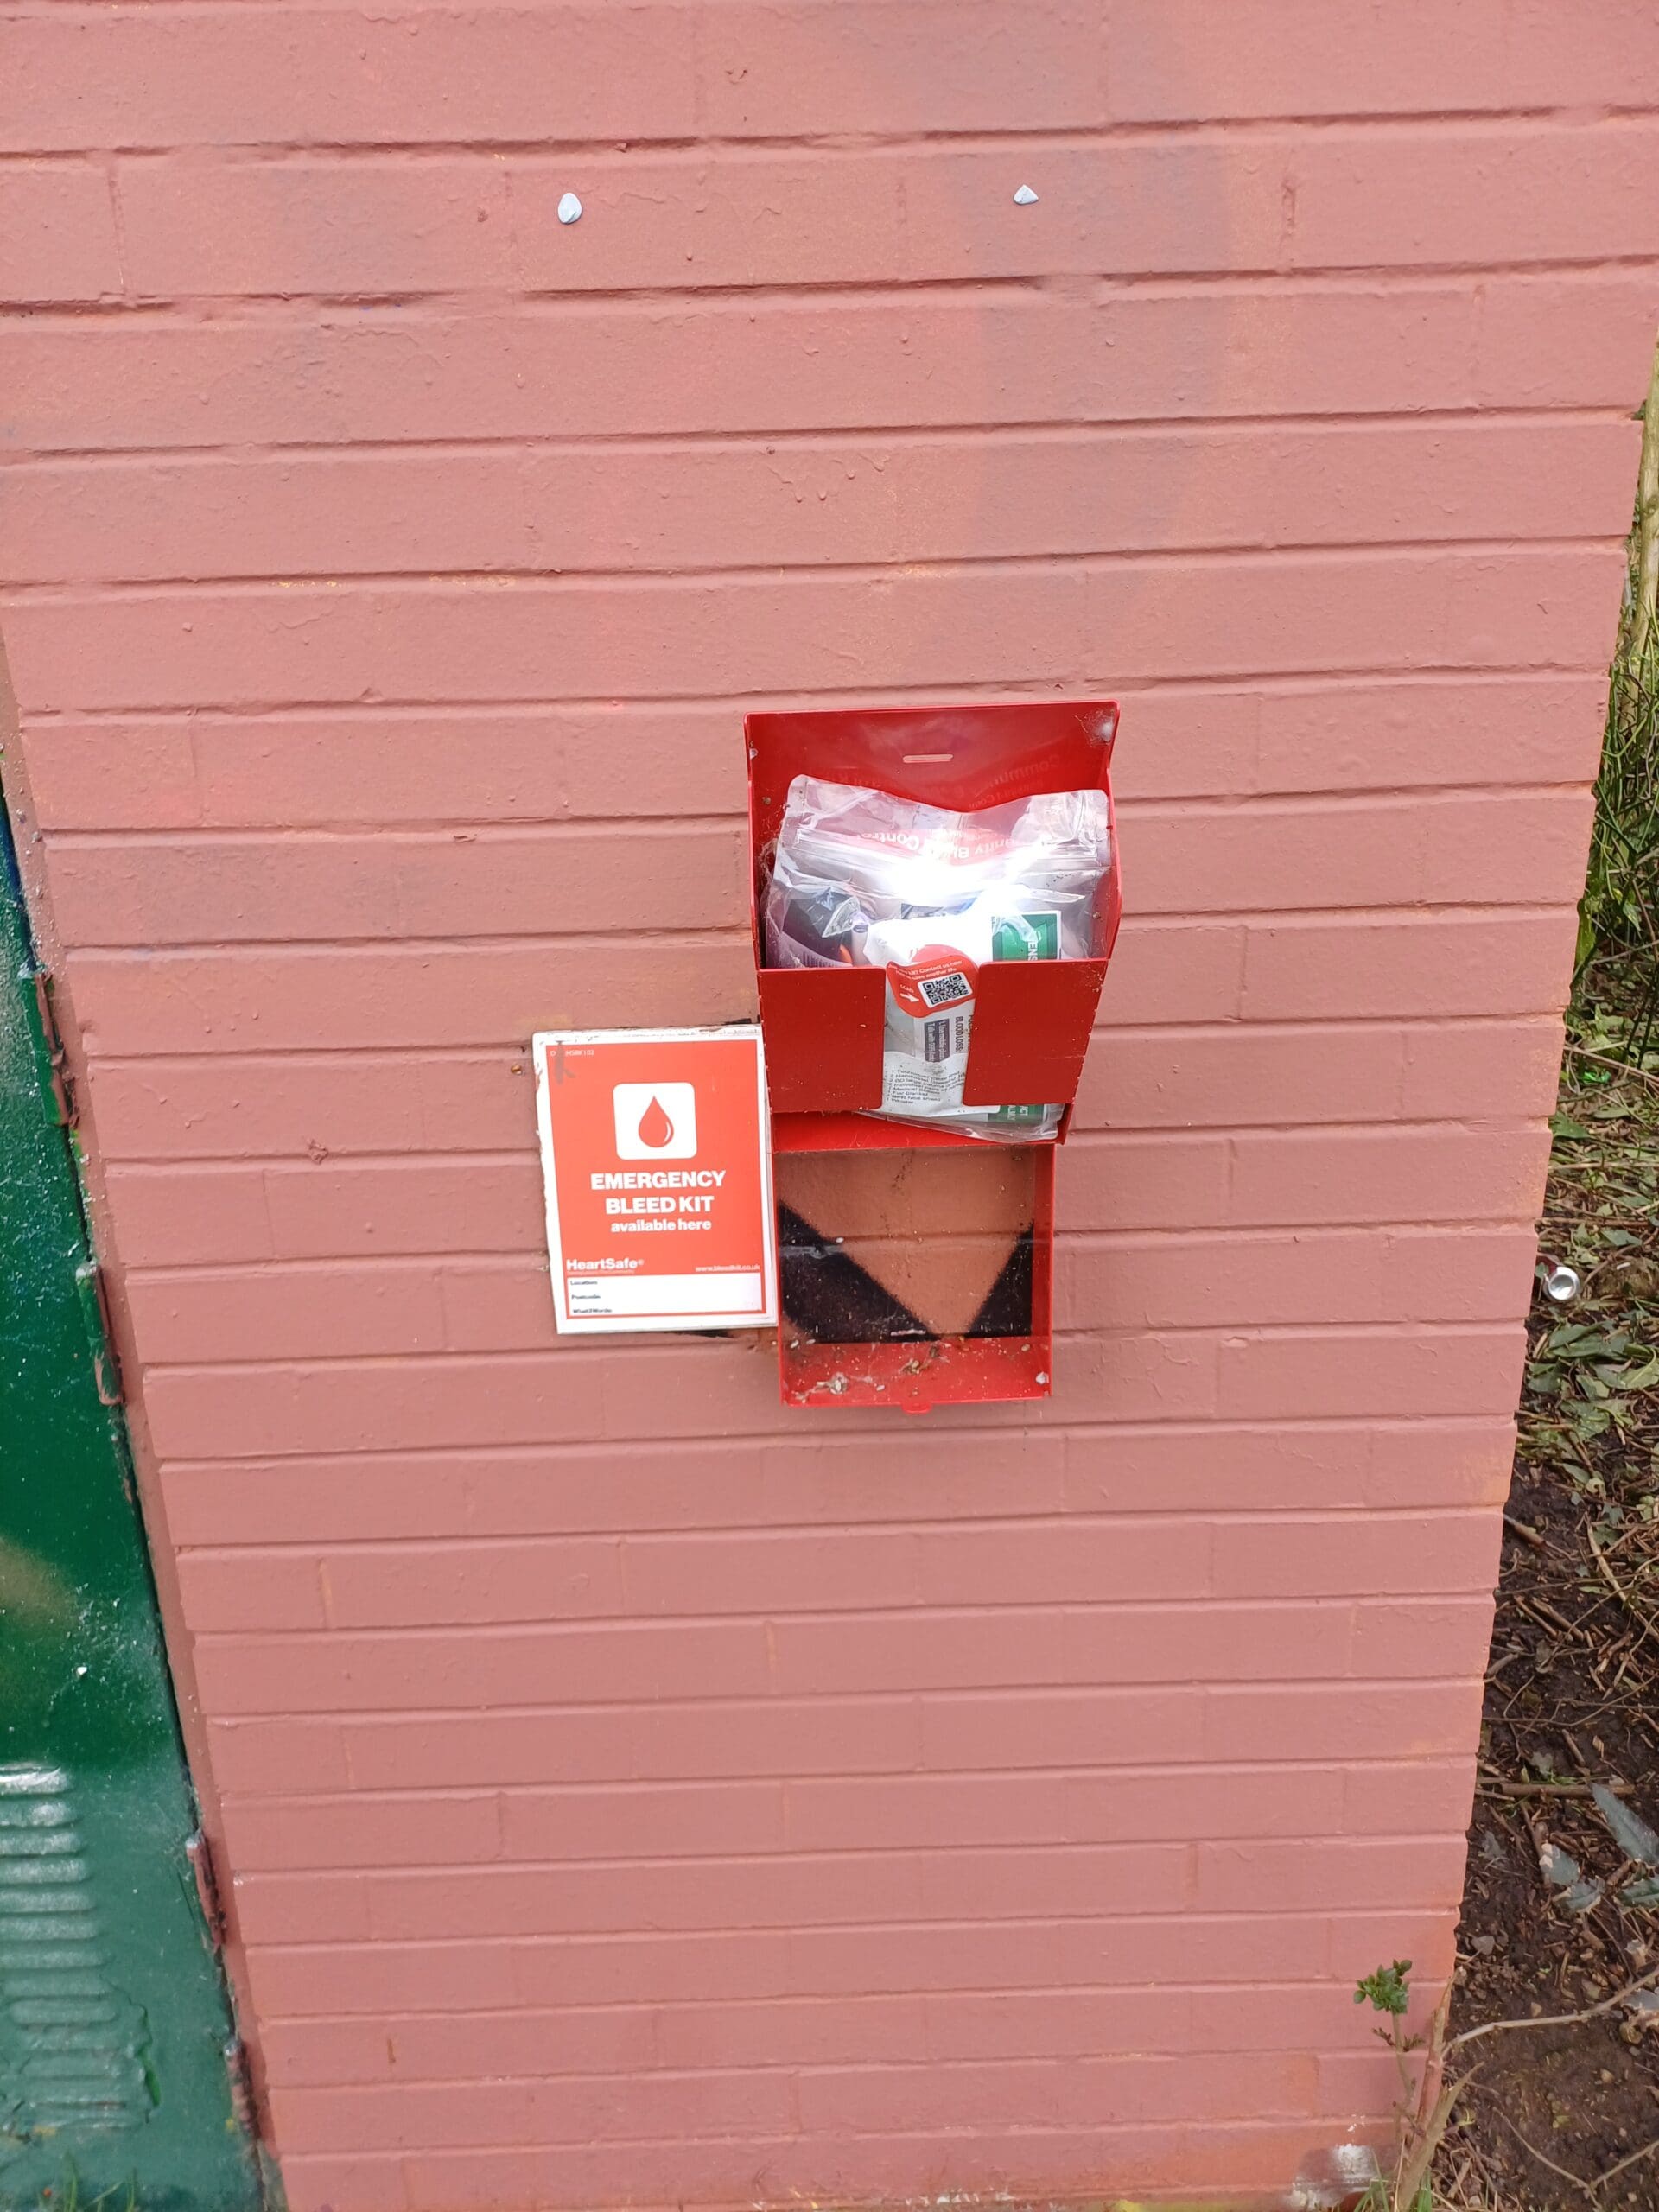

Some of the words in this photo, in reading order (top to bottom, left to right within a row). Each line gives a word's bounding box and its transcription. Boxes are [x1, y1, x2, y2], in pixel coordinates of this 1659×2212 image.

[955, 1016, 964, 1035] BLOOD
[590, 1170, 726, 1190] EMERGENCY
[606, 1196, 677, 1215] BLEED
[678, 1195, 715, 1212] KIT
[610, 1218, 677, 1232] available
[677, 1217, 712, 1230] here
